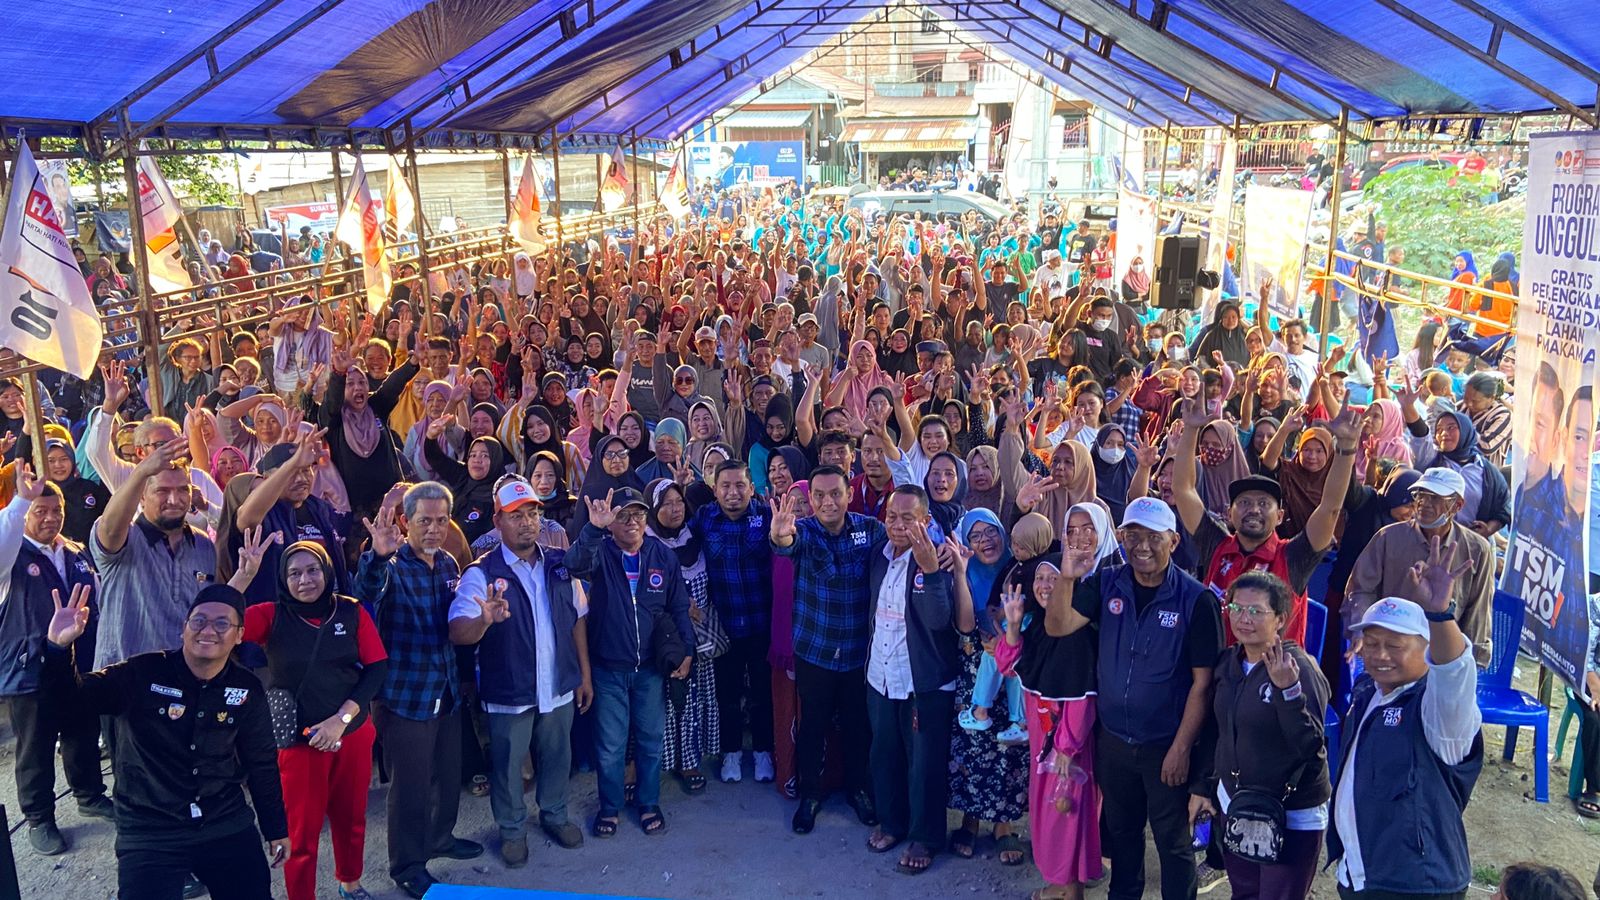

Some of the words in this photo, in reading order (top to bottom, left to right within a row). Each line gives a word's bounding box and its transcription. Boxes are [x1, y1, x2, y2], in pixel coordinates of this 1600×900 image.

[1535, 214, 1600, 262] UNGGUL
[1551, 268, 1593, 290] GRATIS
[1545, 320, 1585, 345] LAHAN
[850, 531, 866, 539] TSM
[854, 538, 867, 546] MO
[1514, 536, 1565, 599] TSM
[1113, 600, 1122, 612] 3
[1158, 612, 1179, 621] TSM
[224, 687, 249, 698] TSM
[1382, 709, 1401, 718] TSM
